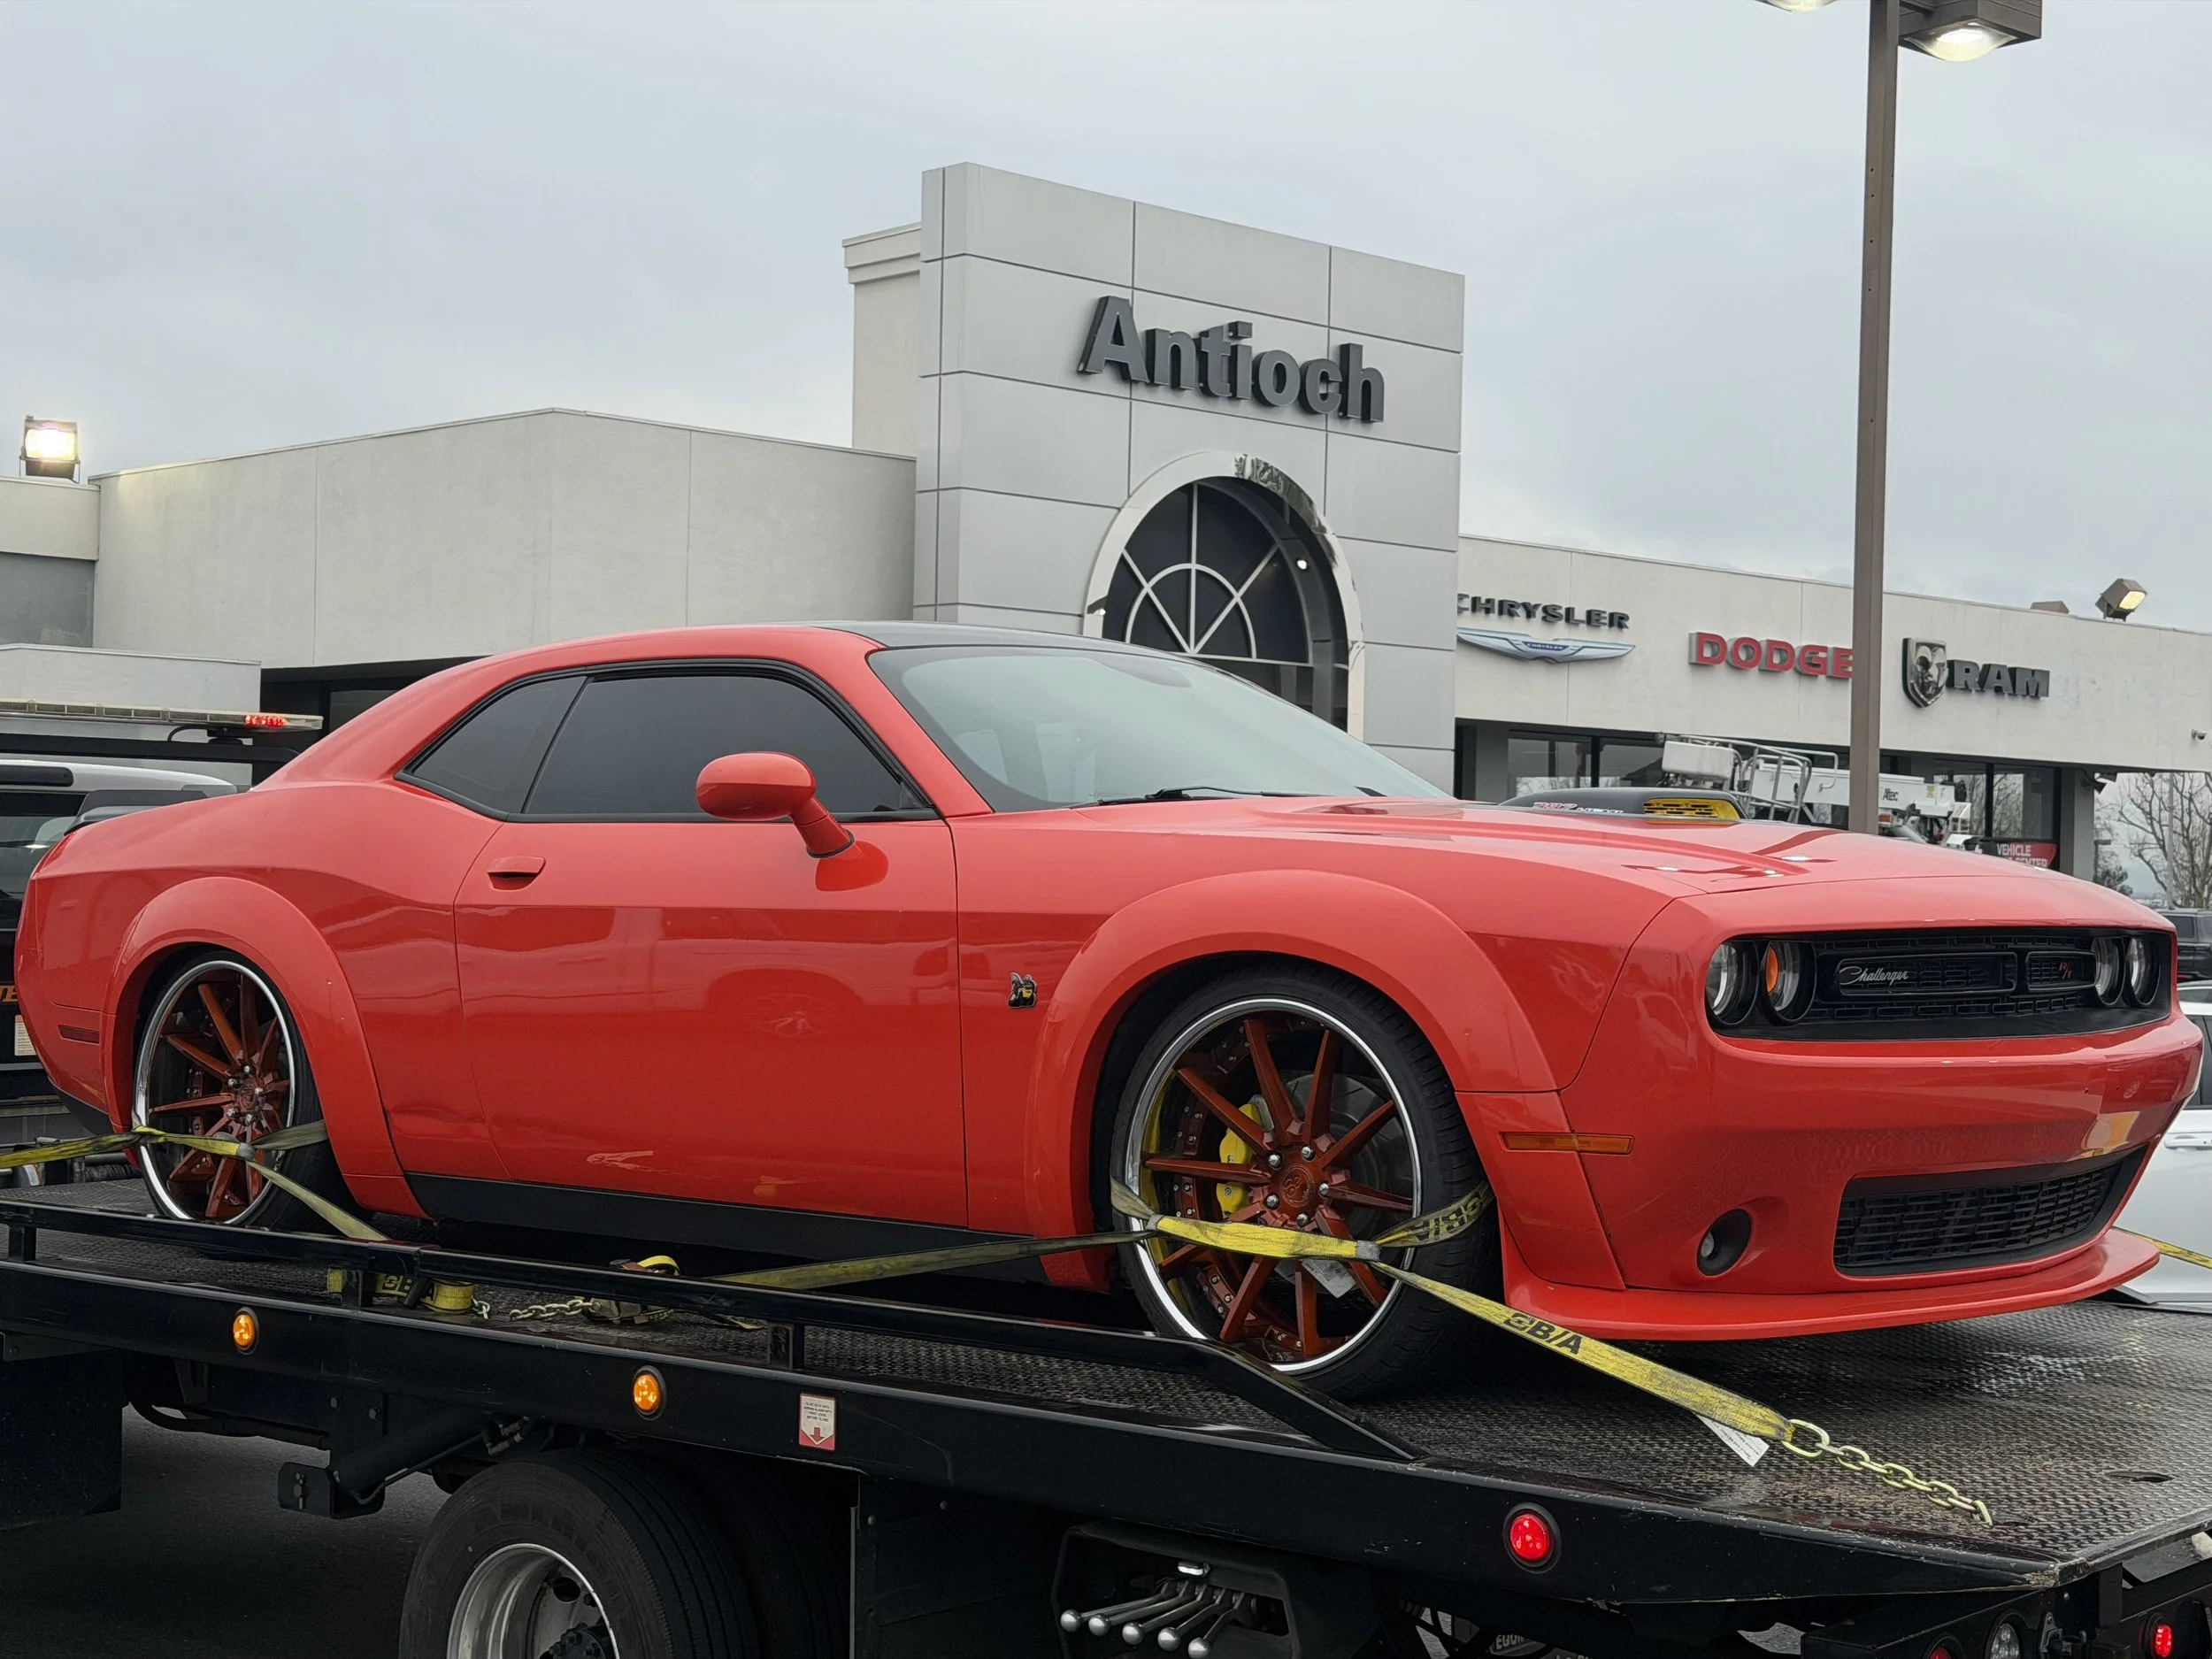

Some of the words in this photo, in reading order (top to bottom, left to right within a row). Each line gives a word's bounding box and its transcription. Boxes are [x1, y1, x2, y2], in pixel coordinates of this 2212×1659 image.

[1077, 295, 1385, 423] Antioch
[1689, 632, 1853, 679] DODGE
[1947, 659, 2050, 698] RAM
[1997, 843, 2032, 856] VEHICLE
[1839, 965, 1909, 986] Challenger
